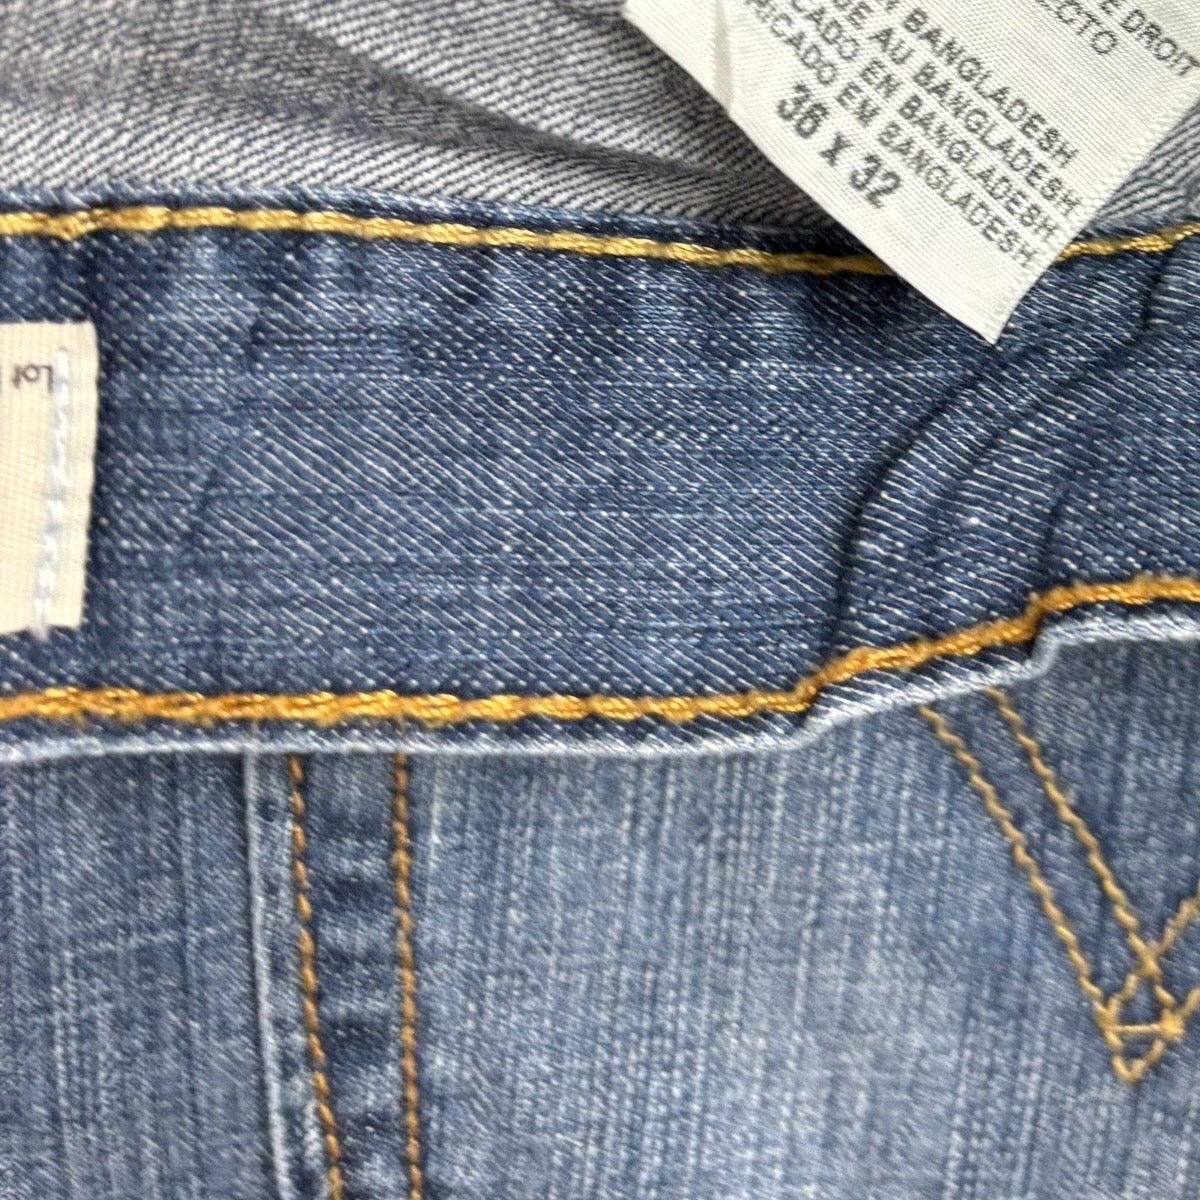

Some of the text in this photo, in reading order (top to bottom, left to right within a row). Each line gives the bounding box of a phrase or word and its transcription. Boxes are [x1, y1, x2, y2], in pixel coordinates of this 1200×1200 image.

[776, 81, 830, 140] 36
[849, 153, 900, 210] 32
[836, 81, 881, 128] EM
[877, 120, 1039, 270] BANGLADESH
[859, 59, 900, 100] EN
[898, 94, 1060, 247] BANGLADESH
[868, 25, 916, 66] AU
[912, 61, 1083, 222] BANGLADESH
[901, 7, 1079, 171] BANGLADESH
